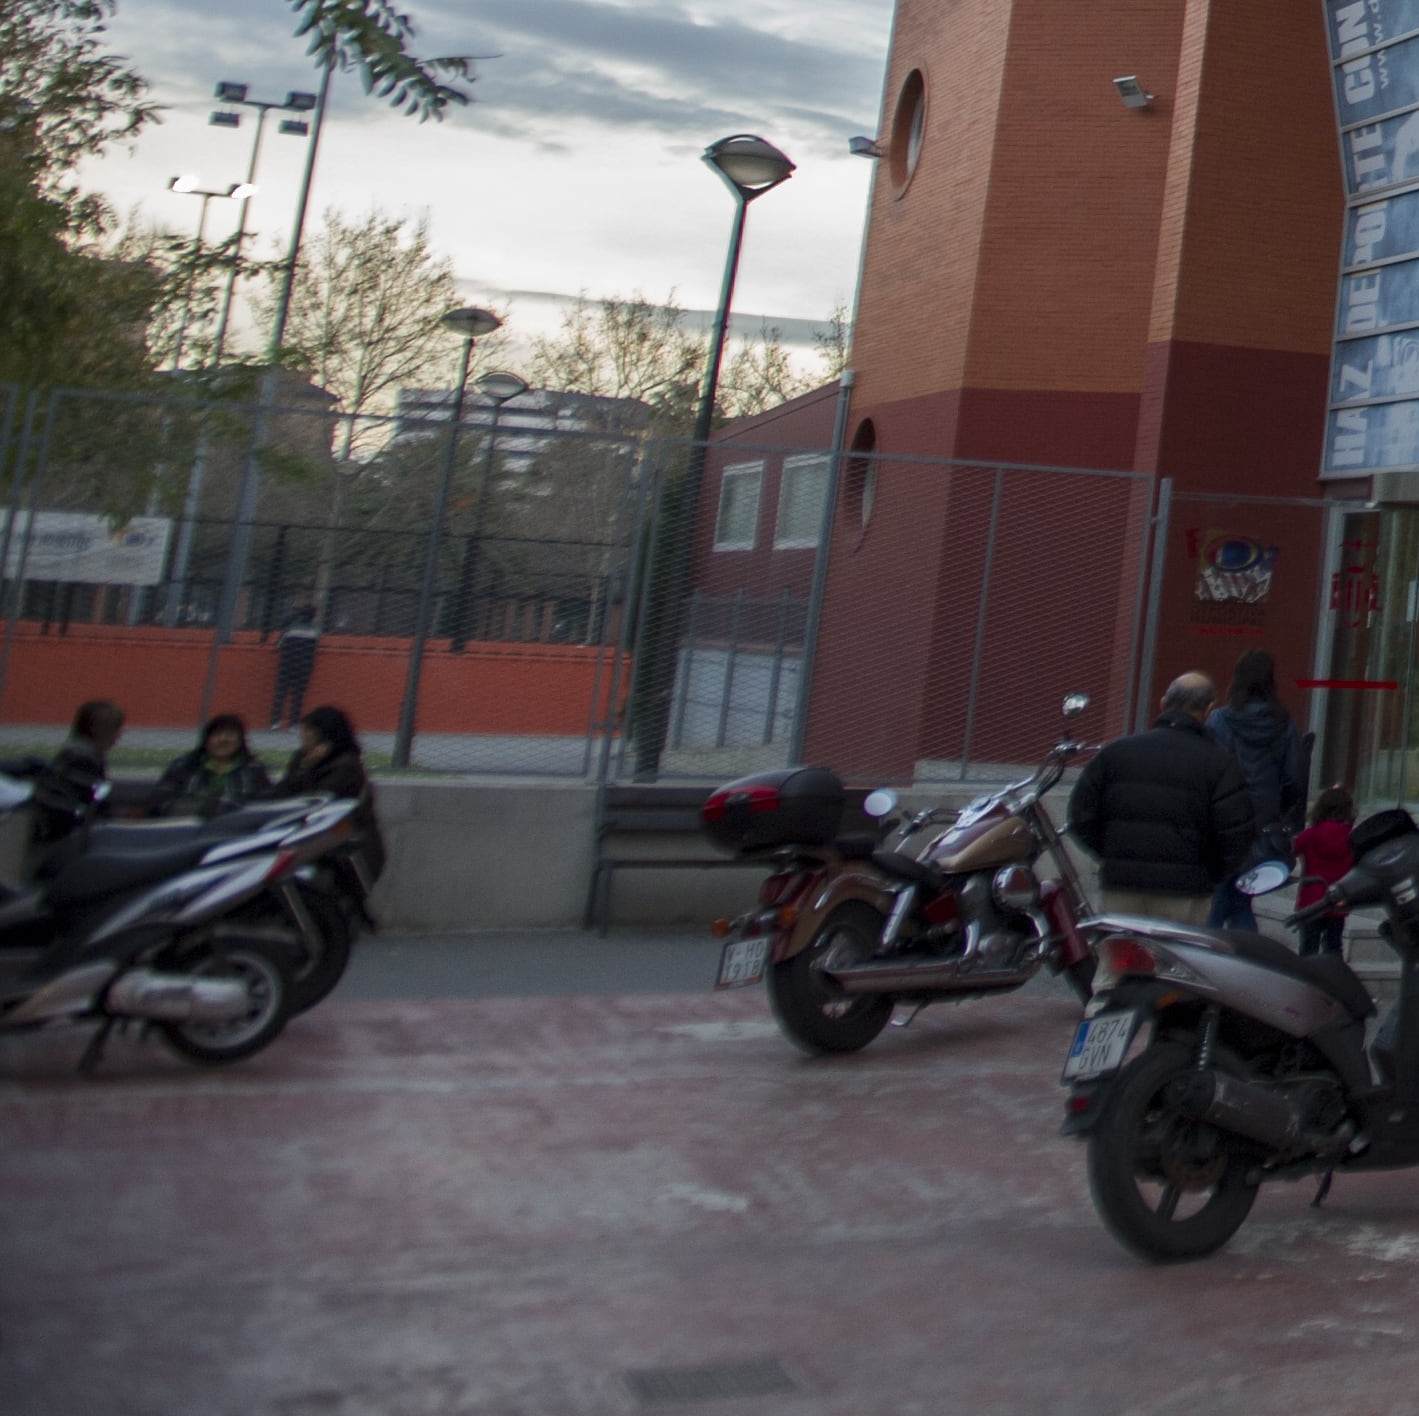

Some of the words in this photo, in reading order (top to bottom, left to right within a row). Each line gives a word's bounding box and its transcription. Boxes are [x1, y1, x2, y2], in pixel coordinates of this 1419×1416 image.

[1335, 0, 1375, 105] CON
[1332, 359, 1373, 466] HAZ
[1078, 1044, 1112, 1070] GVN
[1088, 1018, 1128, 1045] 4874
